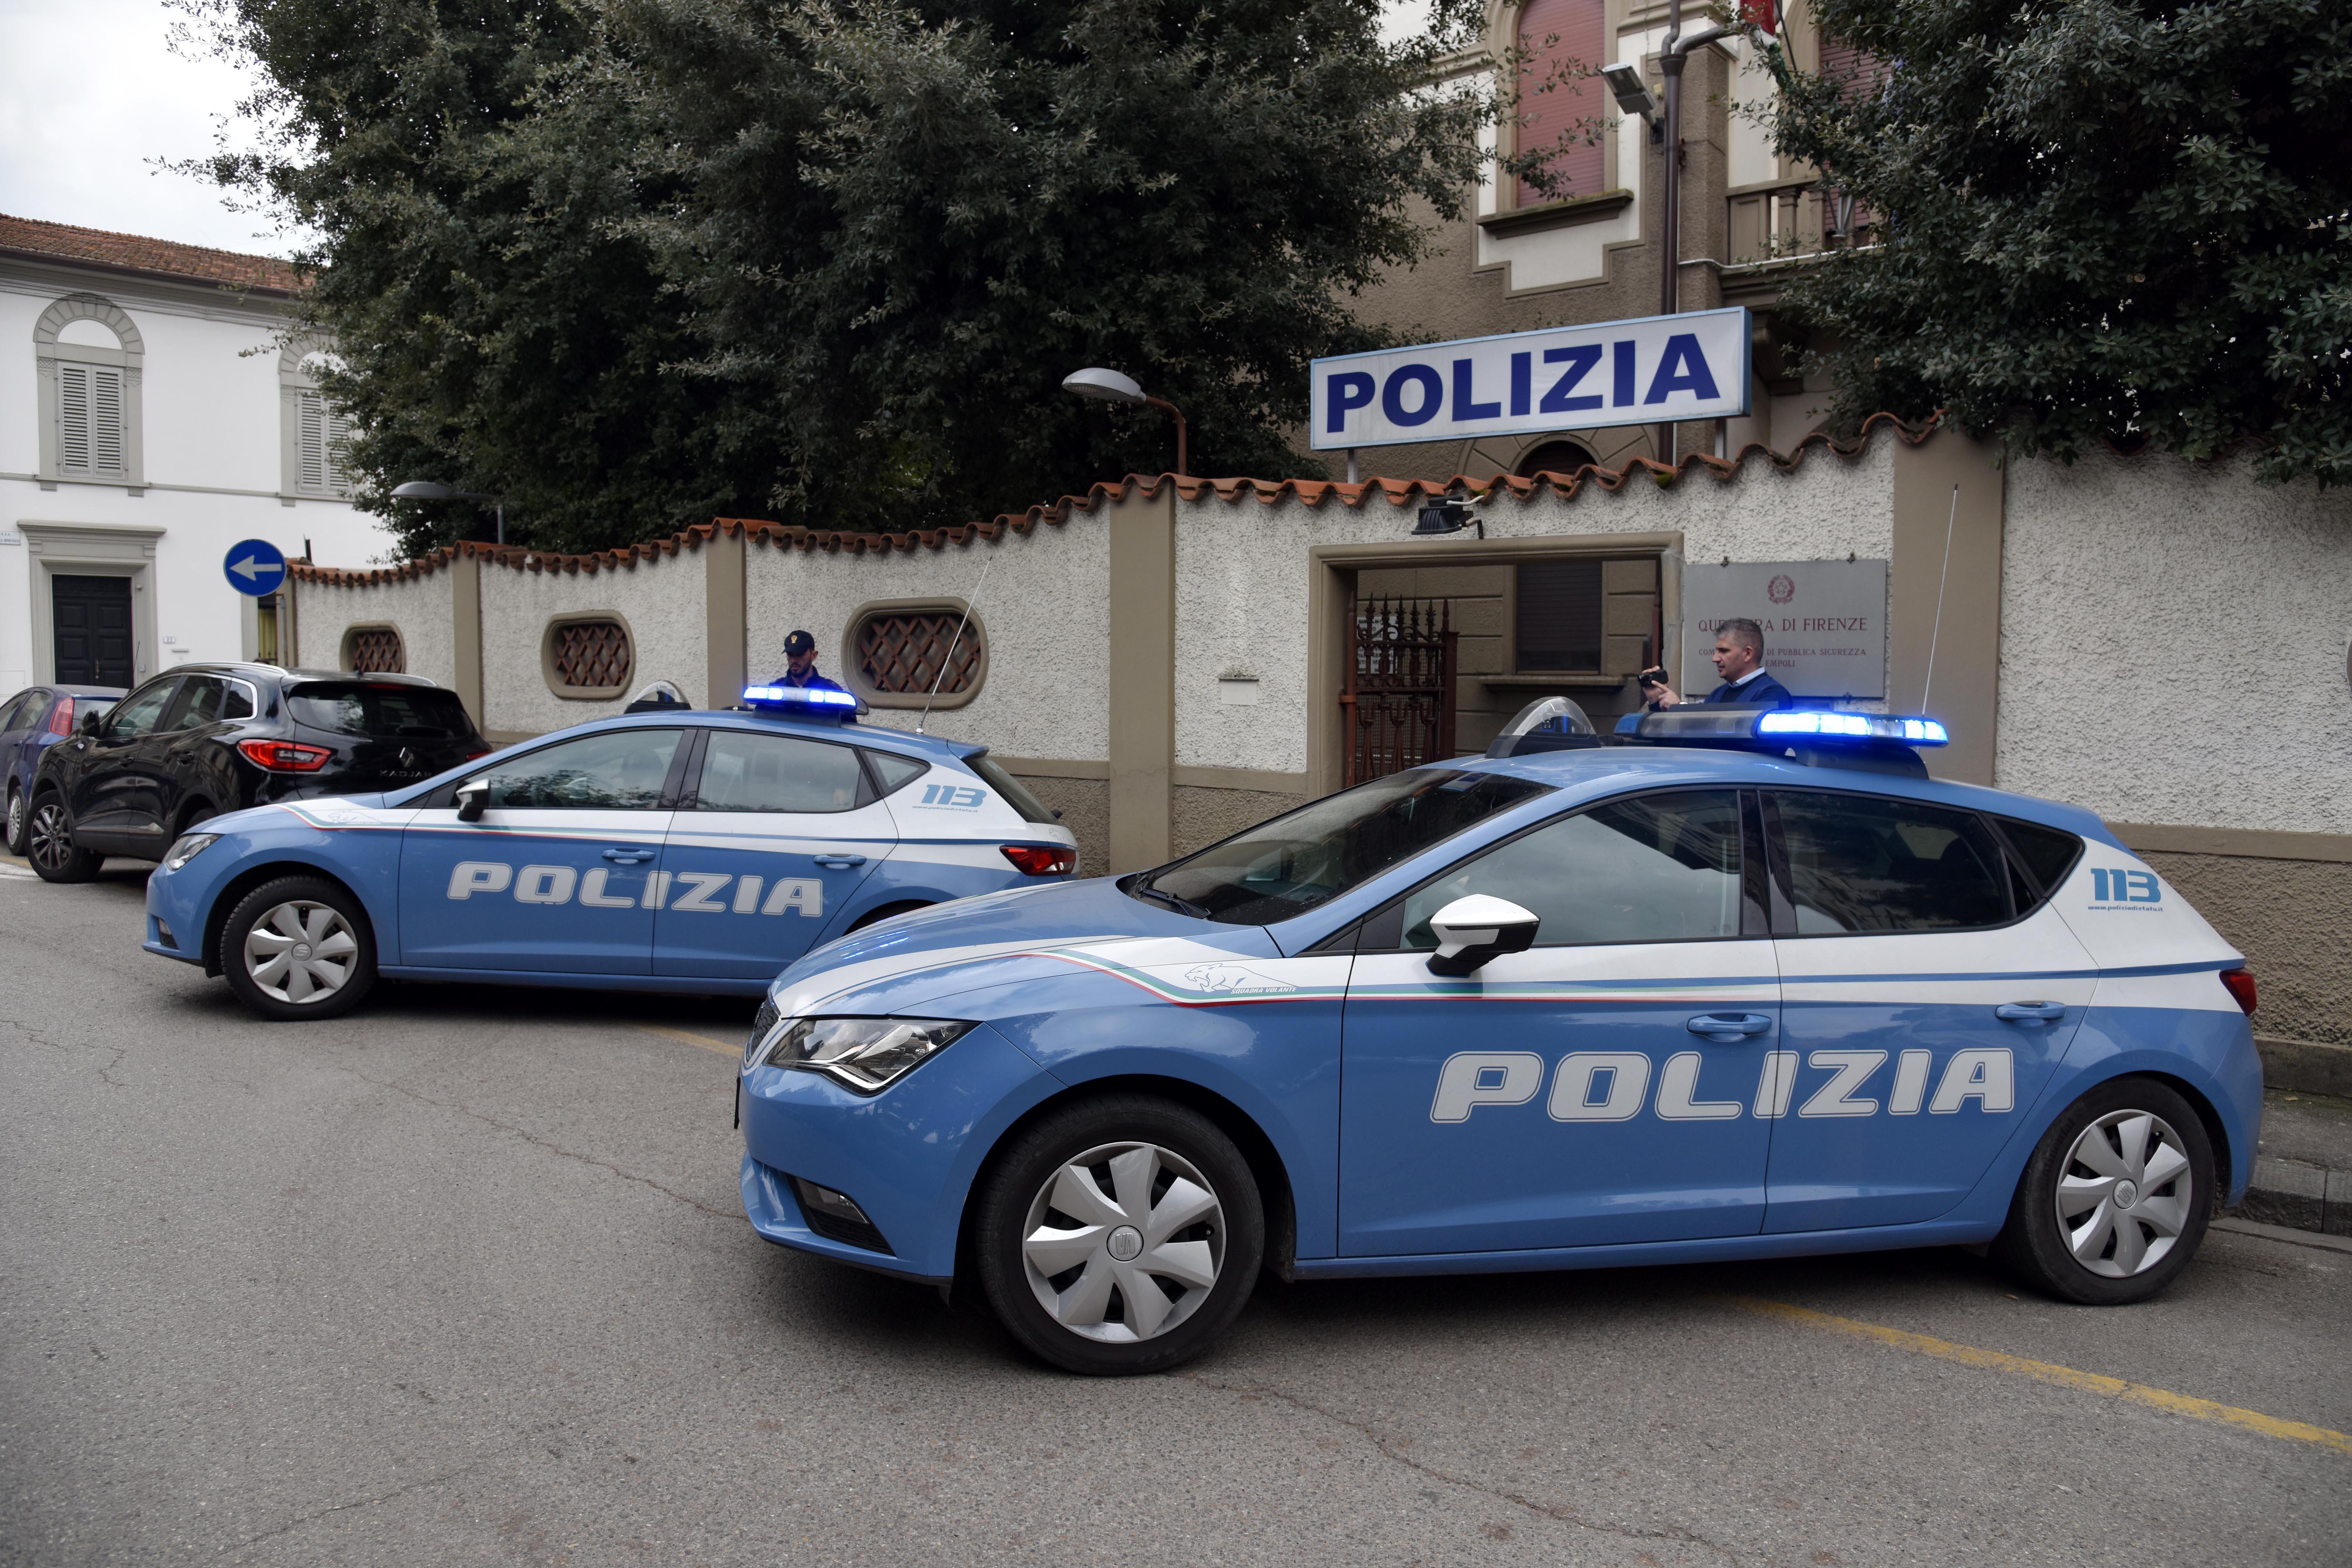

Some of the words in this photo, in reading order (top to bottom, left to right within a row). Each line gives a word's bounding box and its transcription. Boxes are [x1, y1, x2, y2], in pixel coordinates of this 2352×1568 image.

[1326, 333, 1721, 433] POLIZIA
[1698, 619, 1774, 632] QURA
[1782, 619, 1795, 631] DI
[1804, 618, 1867, 631] FIRENZE
[921, 784, 987, 807] 113
[447, 861, 823, 917] POLIZIA
[2091, 868, 2161, 903] 113
[1429, 1047, 2014, 1123] POLIZIA
